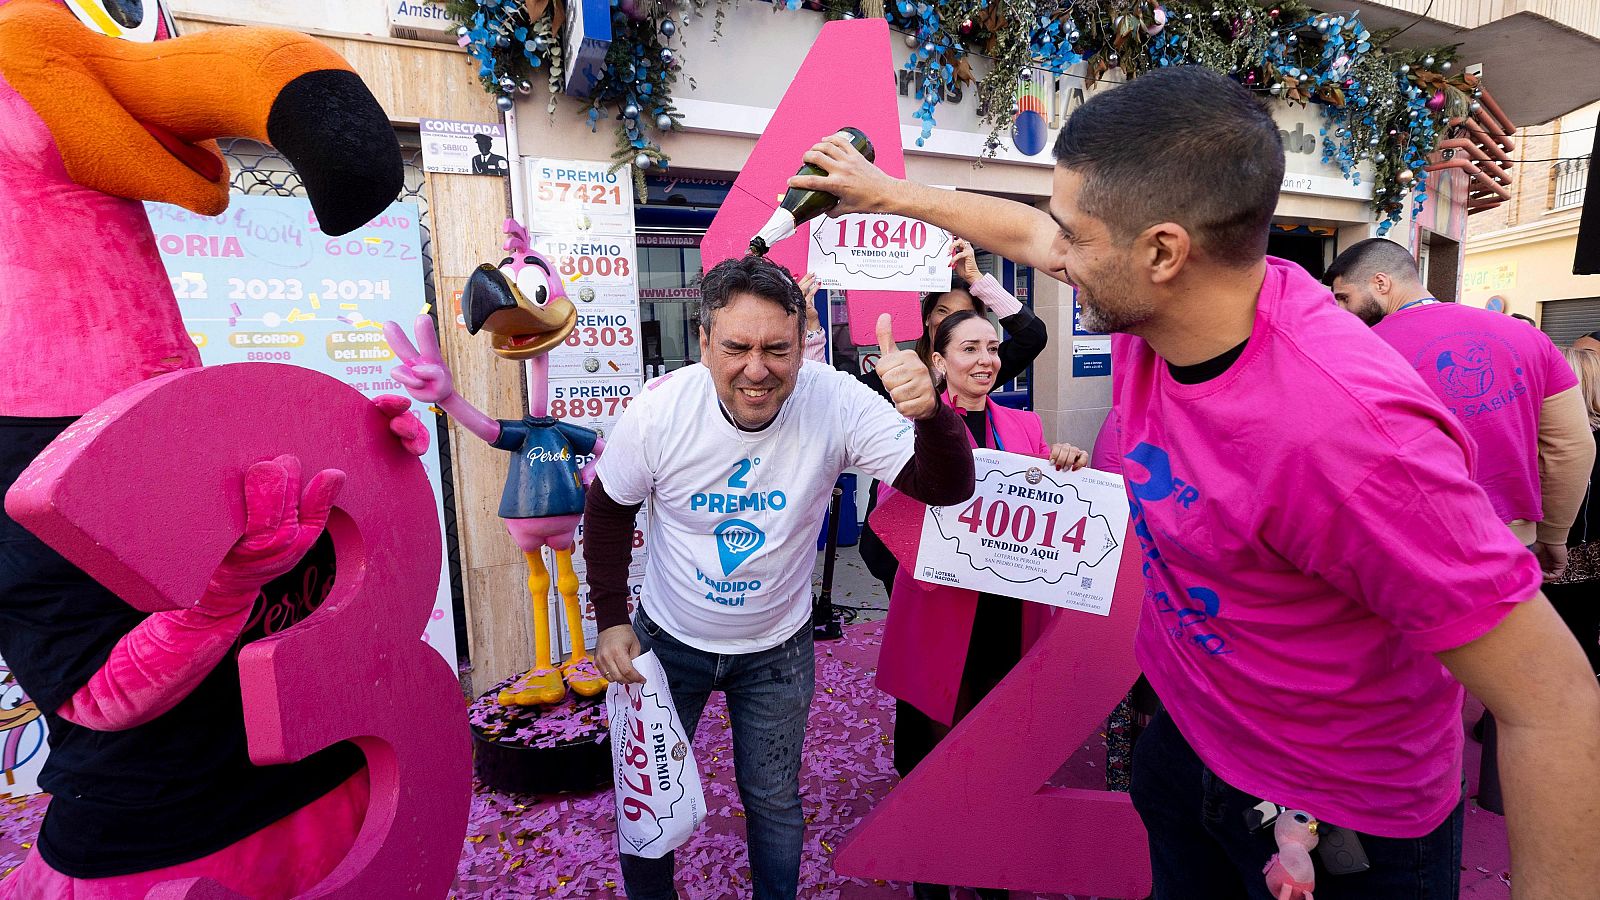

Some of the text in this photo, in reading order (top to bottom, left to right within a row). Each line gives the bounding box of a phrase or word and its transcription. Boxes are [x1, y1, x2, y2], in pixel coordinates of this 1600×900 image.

[425, 120, 500, 135] CONECTADA
[557, 169, 617, 184] PREMIO
[1307, 179, 1312, 190] 2
[537, 182, 621, 205] 57421
[834, 219, 927, 250] 11840
[155, 233, 245, 258] ORIA
[558, 243, 621, 256] PREMIO
[851, 249, 887, 258] VENDIDO
[171, 276, 391, 300] 22 2023 2024
[576, 315, 627, 327] REMIO
[235, 334, 299, 344] EL GORDO
[331, 333, 346, 342] EL
[564, 326, 634, 347] 8303
[247, 351, 291, 361] 88008
[345, 365, 383, 375] 94974
[569, 385, 631, 398] PREMIO
[526, 446, 571, 467] Perolo
[975, 456, 1000, 464] NAVIDAD
[690, 490, 787, 514] PREMIO
[1007, 484, 1065, 505] PREMIO
[957, 495, 1088, 554] 40014
[980, 537, 1060, 561] VENDIDO AQUÍ
[695, 567, 762, 593] VENDIDO
[705, 591, 745, 607] AQUÍ
[652, 733, 671, 791] PREMIO
